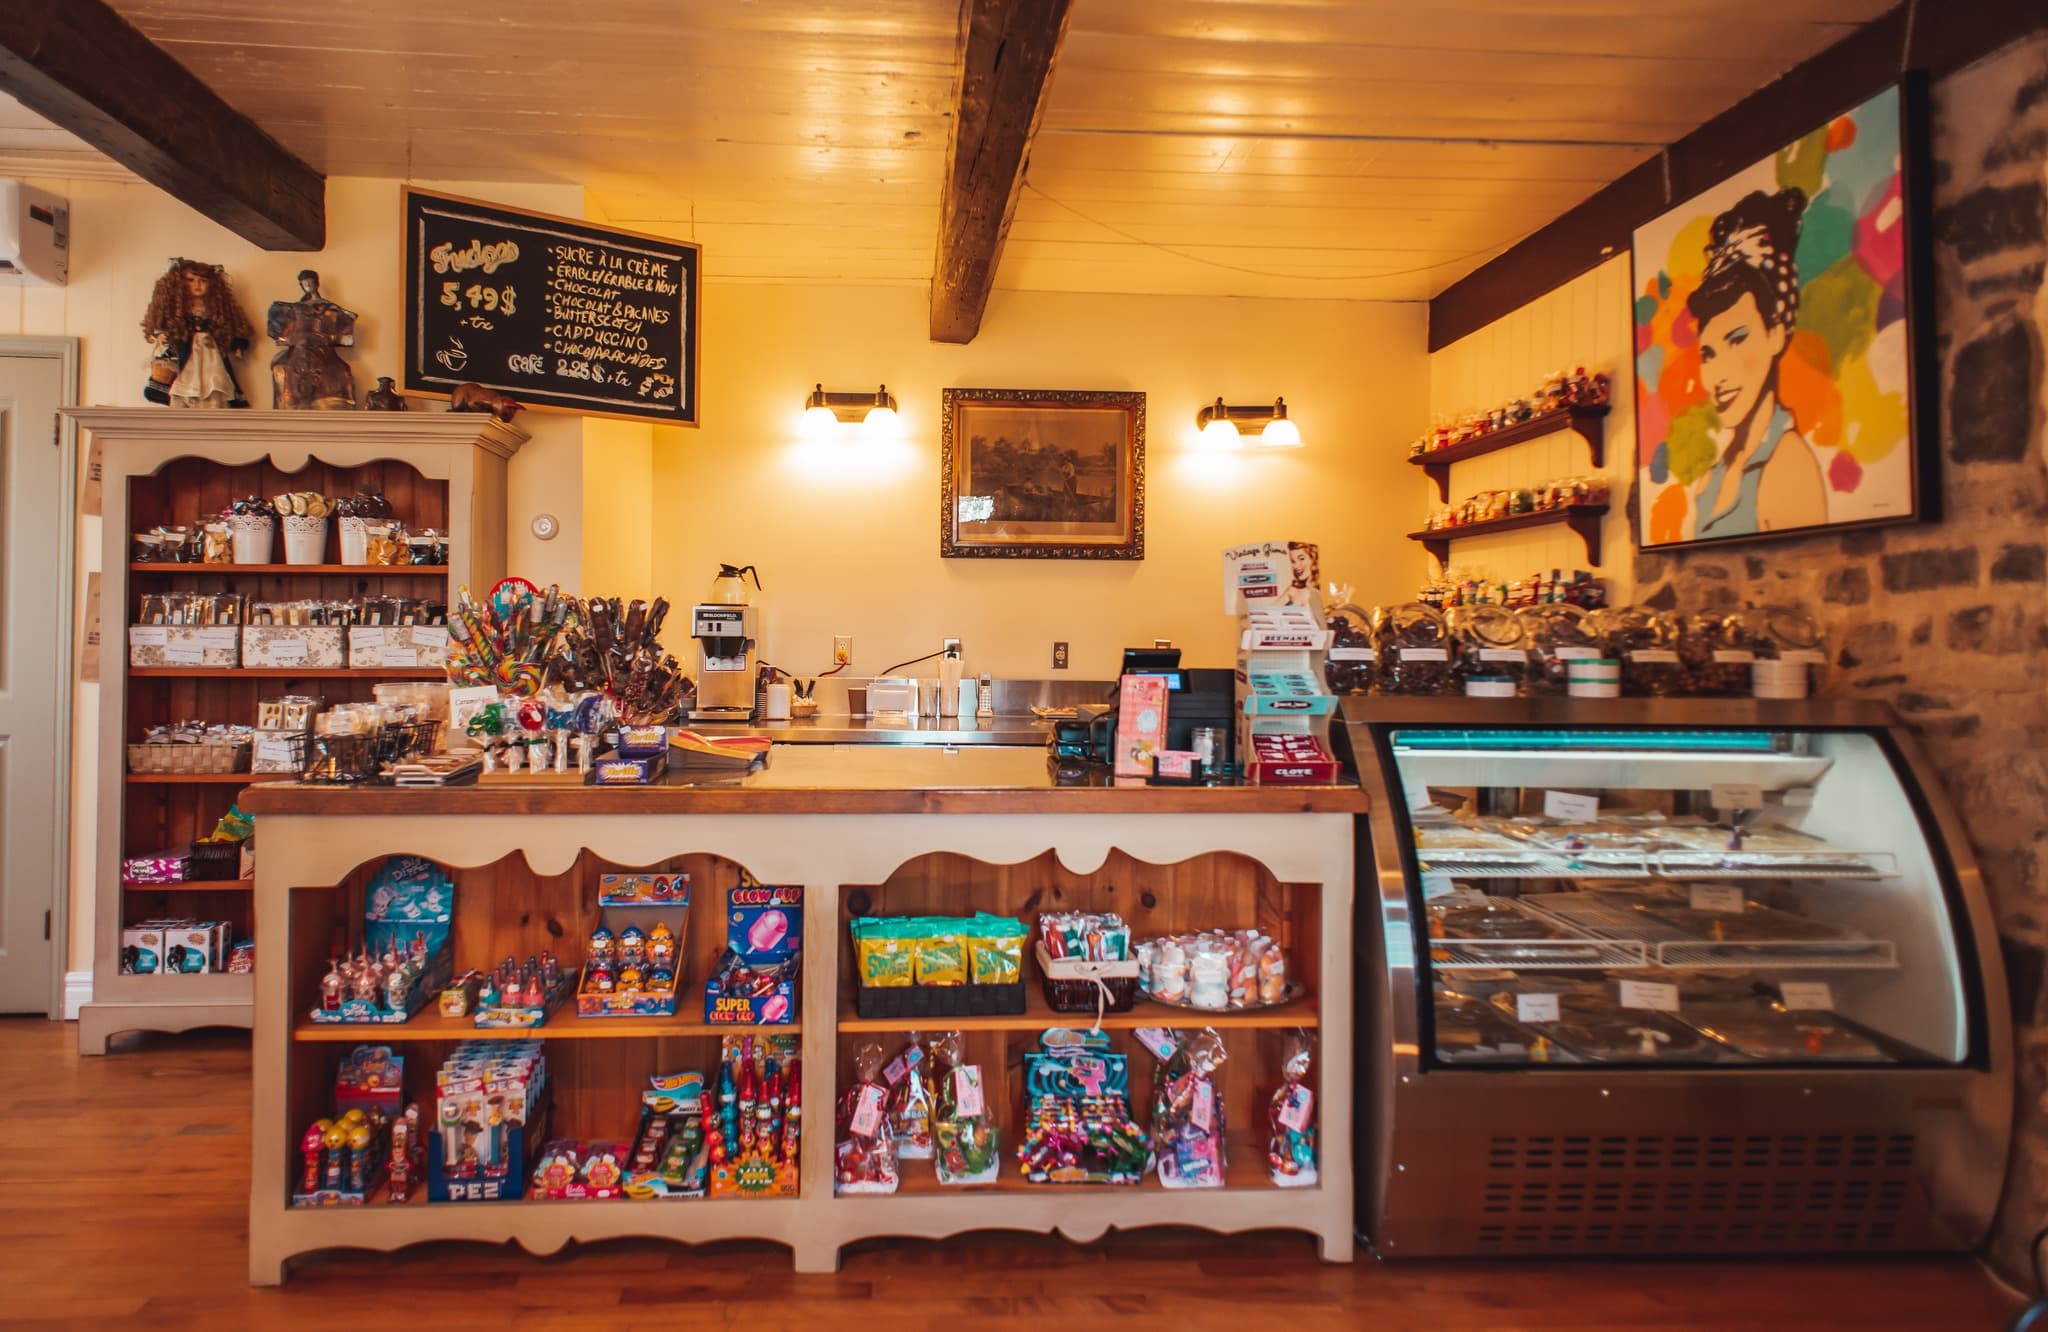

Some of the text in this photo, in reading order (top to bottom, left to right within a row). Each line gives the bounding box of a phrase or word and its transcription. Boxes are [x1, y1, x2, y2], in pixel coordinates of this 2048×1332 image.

[555, 246, 594, 265] SUCRE
[610, 256, 622, 270] LA
[627, 258, 669, 279] CRÈME
[554, 279, 621, 300] CHOCOLAT
[552, 293, 612, 314] CHOCOLAT
[624, 304, 671, 324] PACANES
[554, 306, 644, 335] BUTTERSCOTCH
[732, 889, 771, 904] BLOW
[716, 997, 750, 1012] SUPER
[448, 1183, 499, 1200] PEZ
